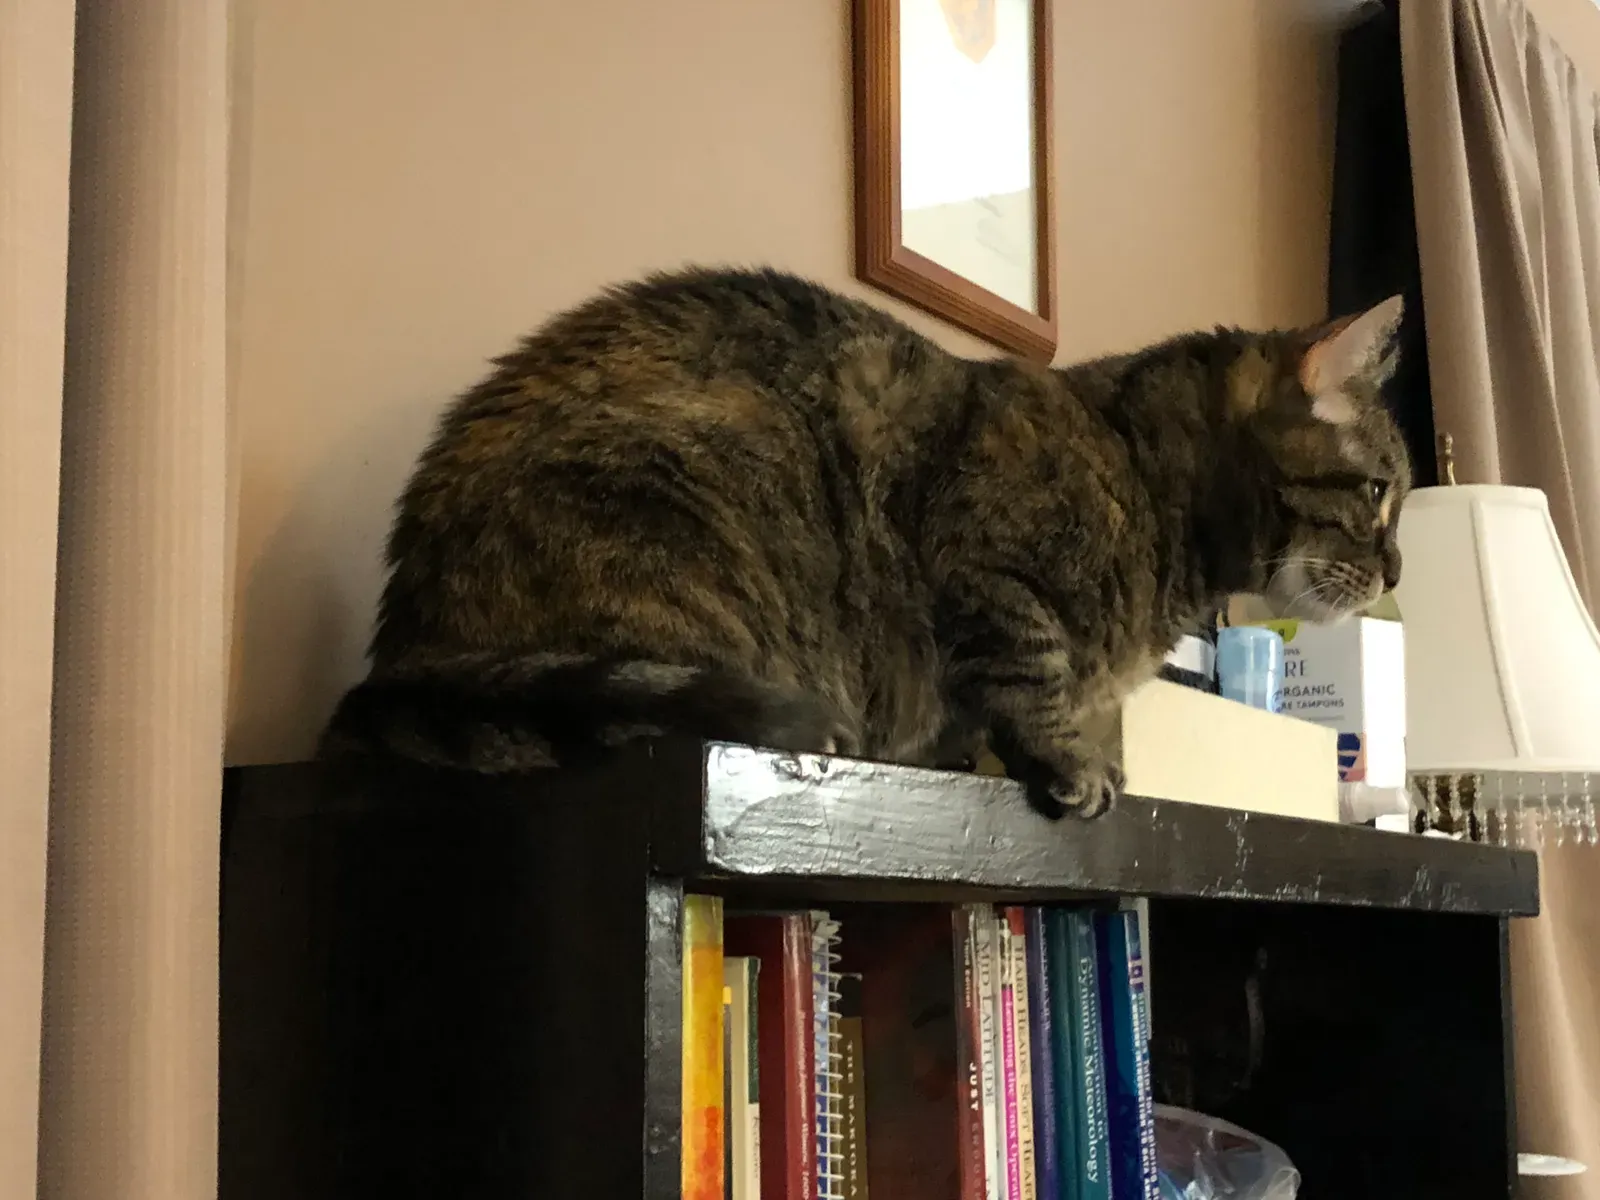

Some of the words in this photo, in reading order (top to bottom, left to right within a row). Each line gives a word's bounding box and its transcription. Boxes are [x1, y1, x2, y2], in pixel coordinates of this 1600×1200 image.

[1283, 683, 1336, 697] RGANIC
[1297, 698, 1344, 708] TAMPONS
[980, 940, 991, 986] MID
[1016, 945, 1025, 1002] HARD
[1078, 957, 1093, 1048] Dynamic
[982, 994, 995, 1107] LATITUDE
[1005, 999, 1014, 1068] Learning
[969, 1062, 979, 1111] JUST
[1008, 1072, 1016, 1097] the
[1020, 1084, 1031, 1132] SOFT
[1009, 1102, 1017, 1138] Unix
[1084, 1055, 1098, 1183] Meteorology
